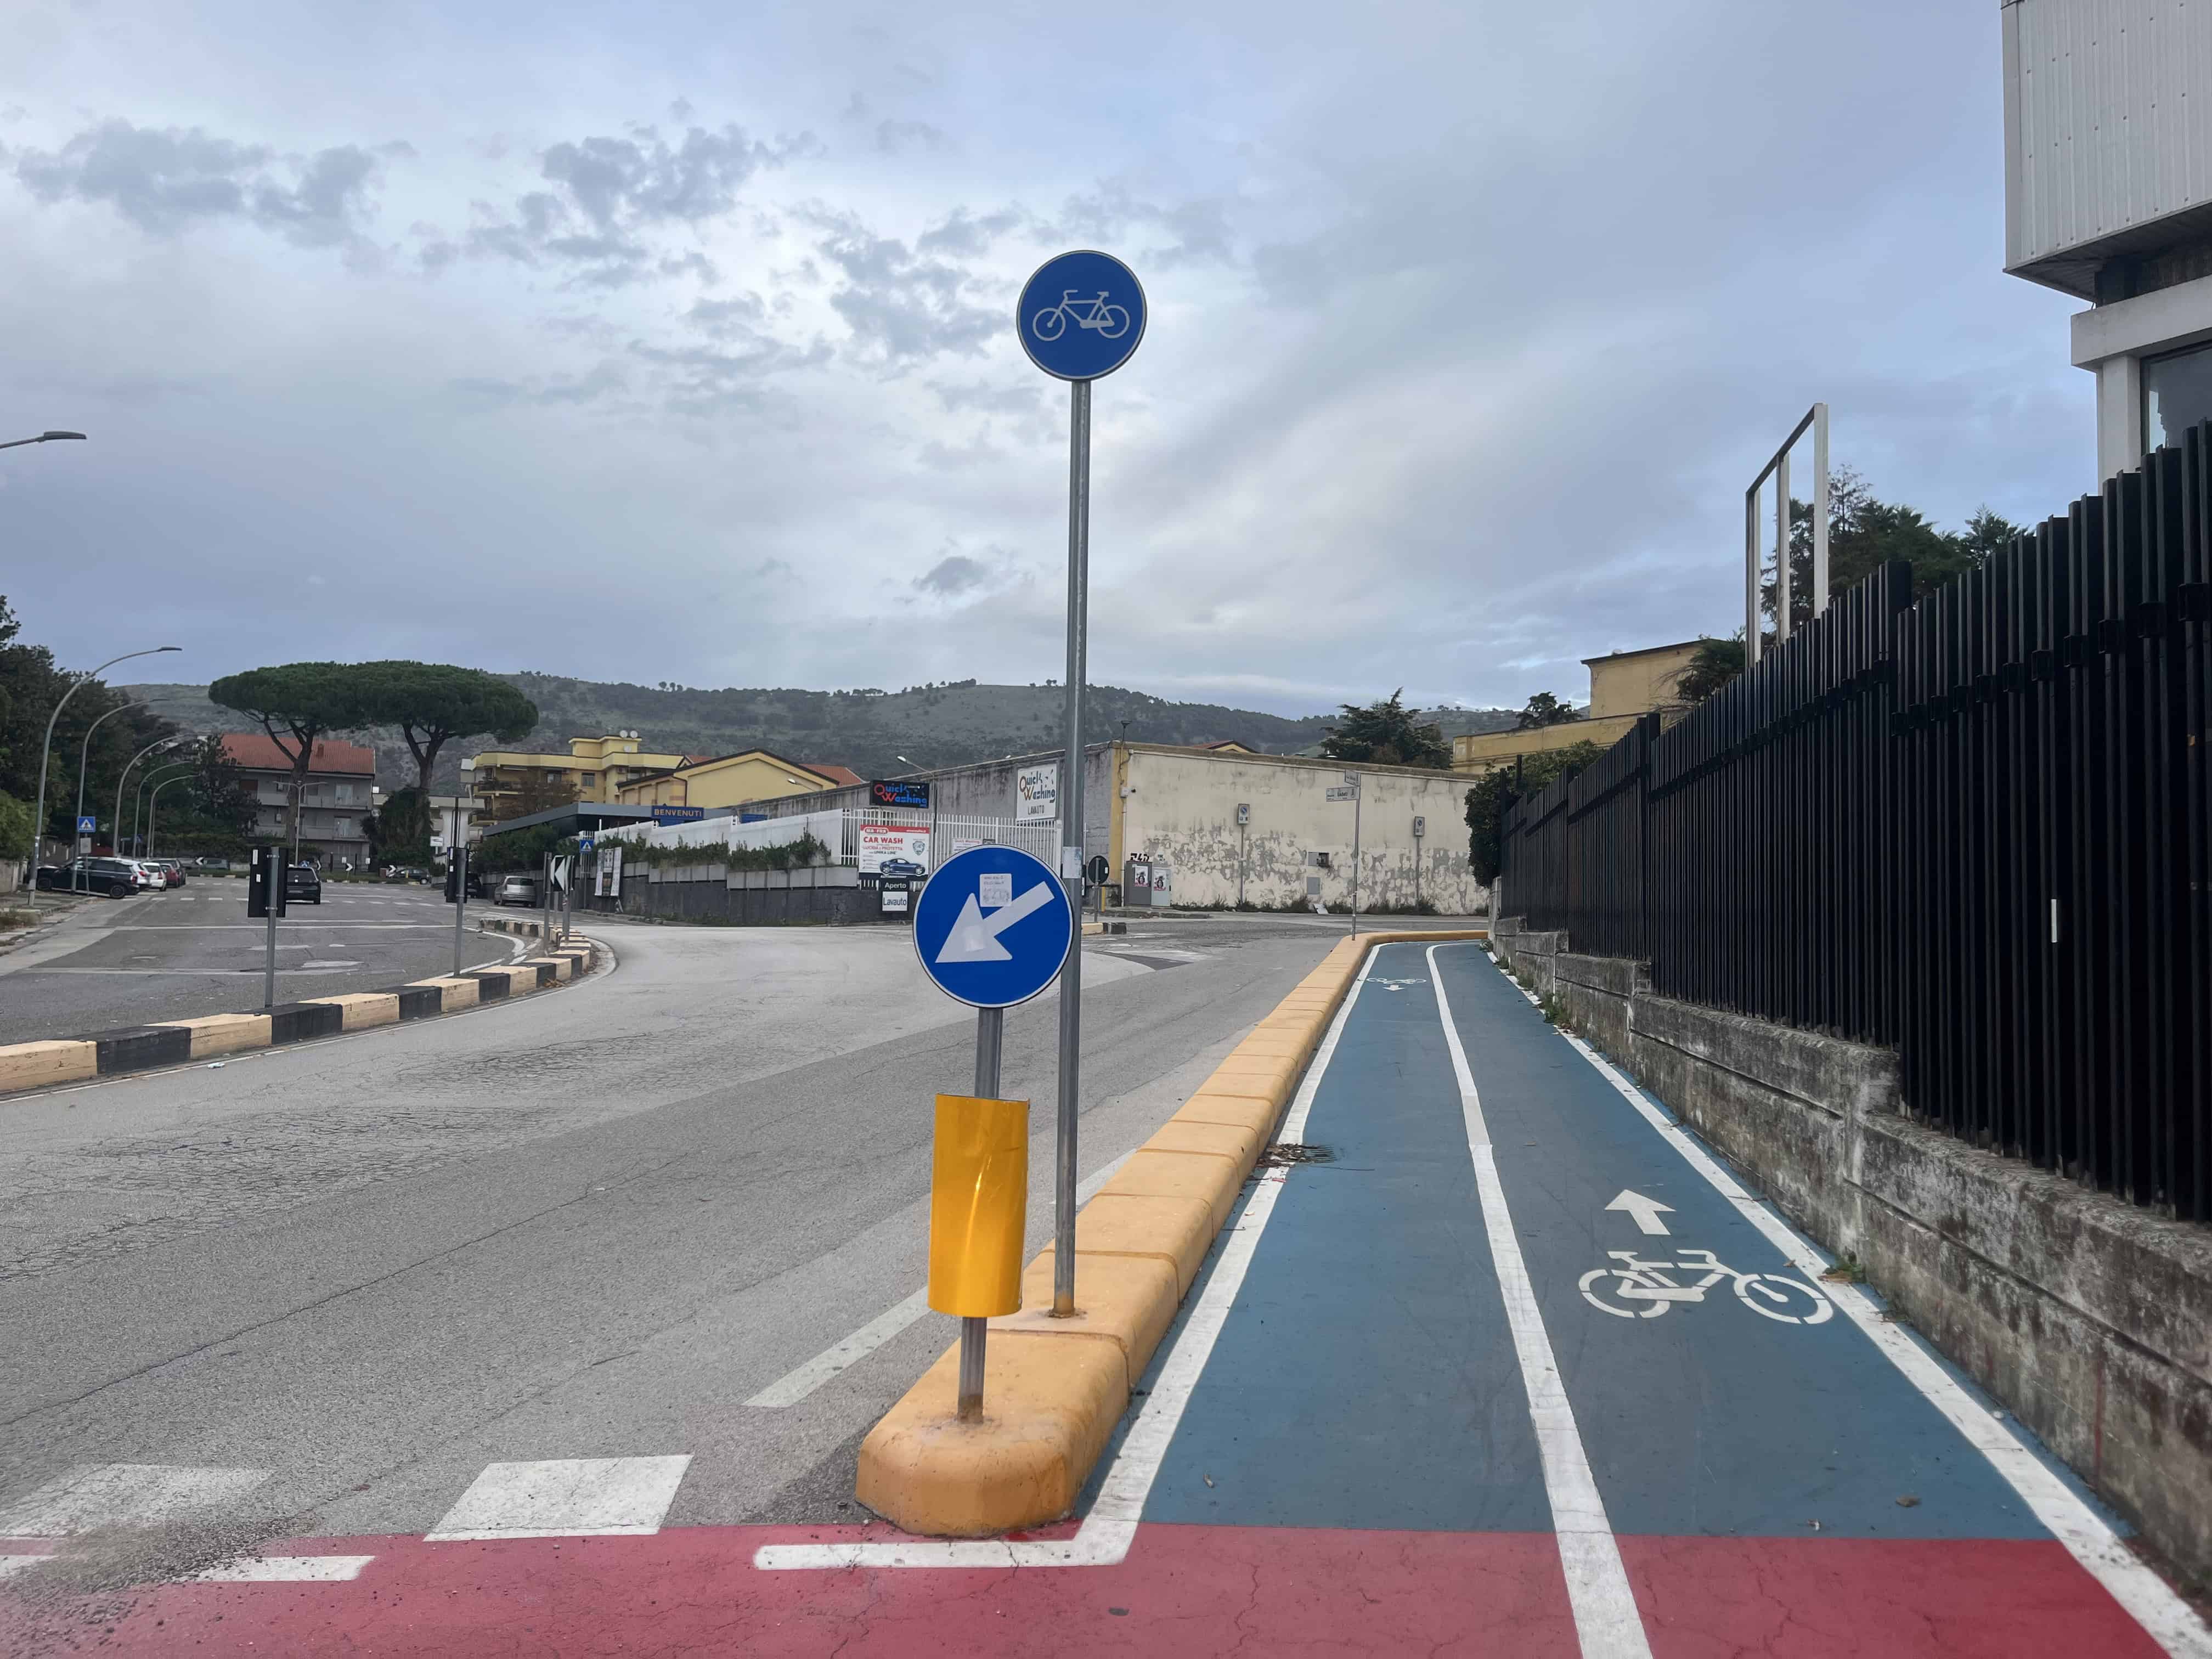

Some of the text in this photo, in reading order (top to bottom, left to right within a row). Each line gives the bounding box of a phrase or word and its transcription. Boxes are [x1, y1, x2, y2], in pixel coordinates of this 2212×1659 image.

[874, 783, 908, 795] Quick
[1019, 771, 1043, 793] Quick
[882, 792, 927, 808] Washing
[1024, 785, 1056, 803] Washing
[654, 809, 702, 817] BENVENUTI
[883, 897, 907, 905] Lavauto
